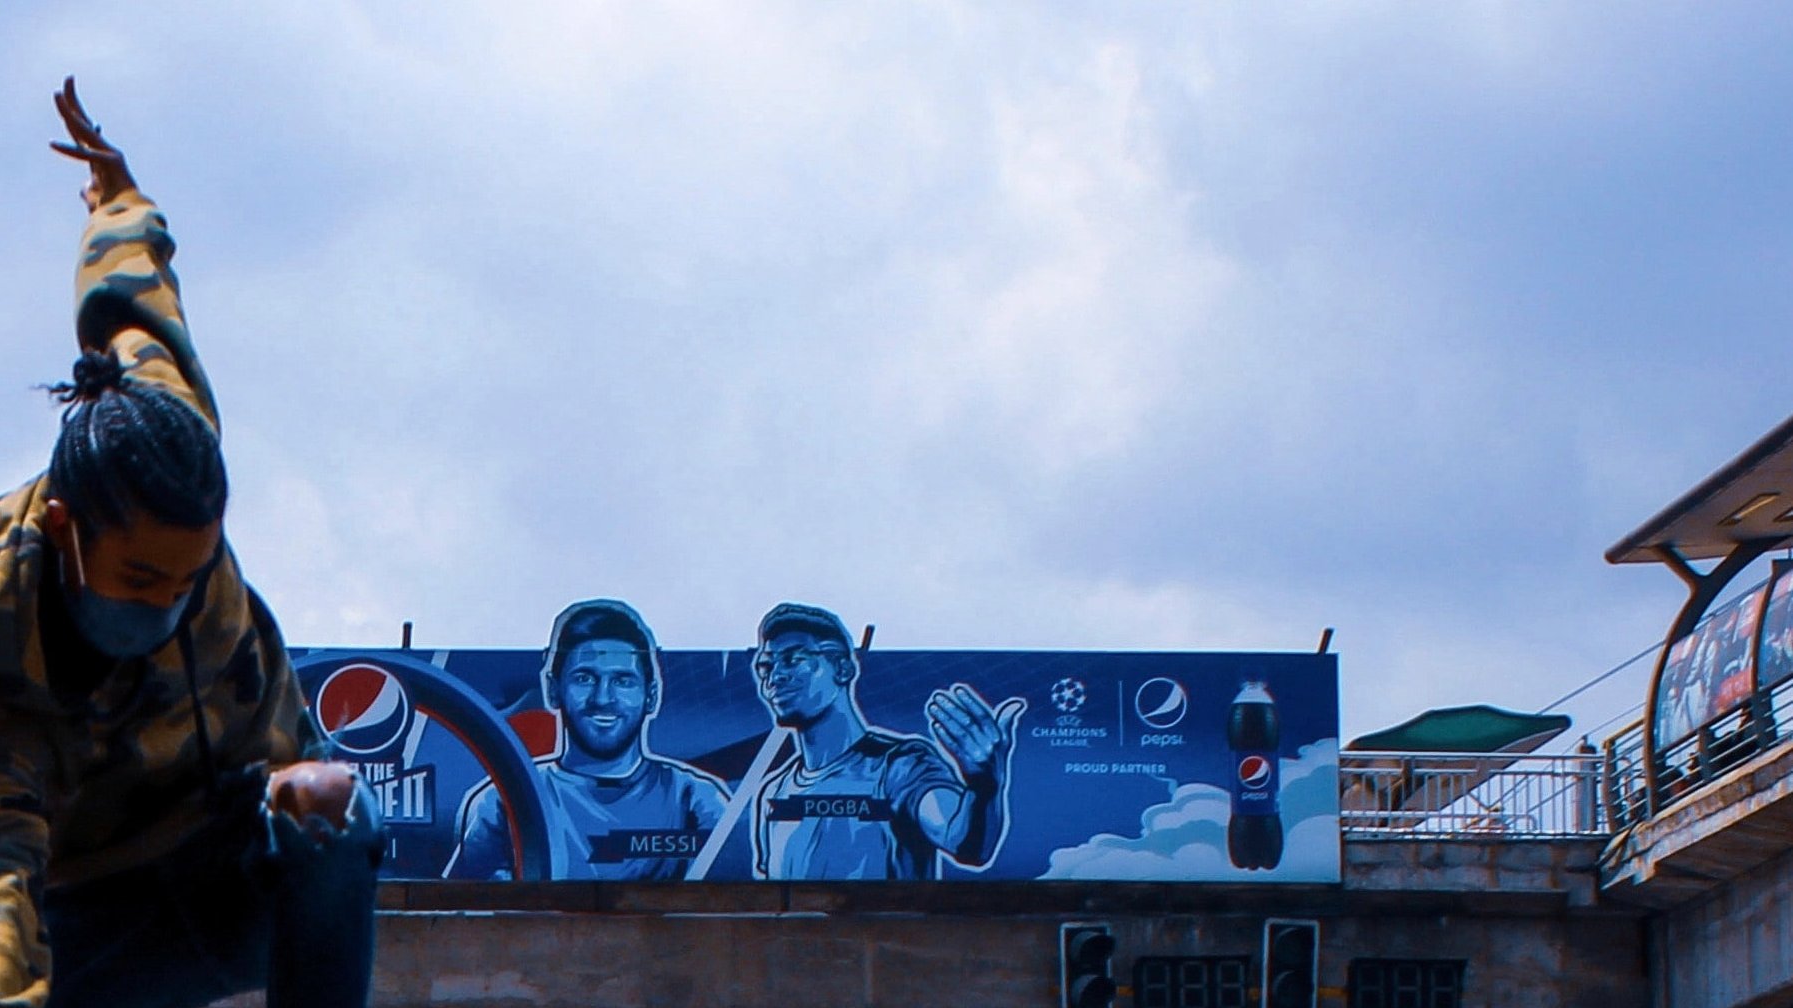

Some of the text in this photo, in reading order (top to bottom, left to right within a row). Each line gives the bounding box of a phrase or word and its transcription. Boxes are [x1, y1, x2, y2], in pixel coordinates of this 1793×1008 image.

[1032, 727, 1107, 738] CHAMPIONS
[1141, 733, 1183, 747] pepsi
[1050, 739, 1088, 748] LEAGUE
[364, 762, 396, 782] THE
[1065, 763, 1166, 774] PROUD PARTNER
[403, 771, 428, 818] IT
[804, 799, 871, 816] POGBA
[630, 834, 697, 852] MESSI
